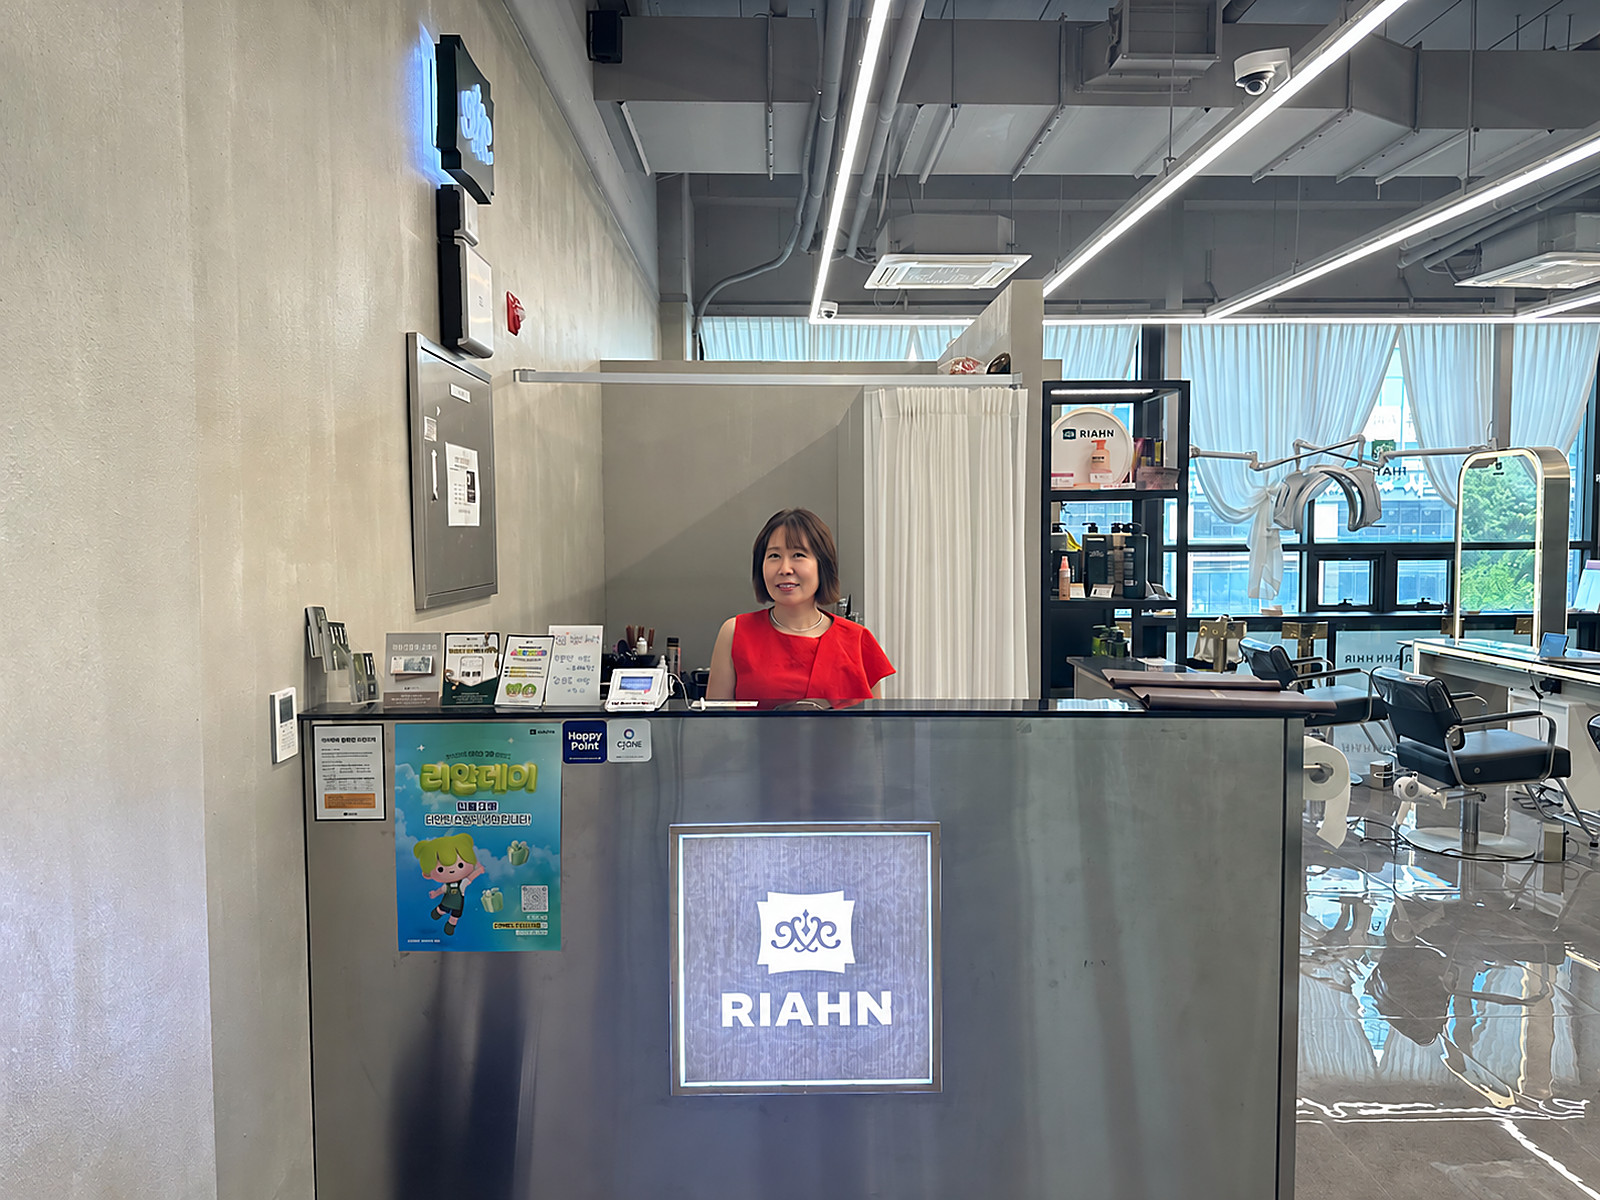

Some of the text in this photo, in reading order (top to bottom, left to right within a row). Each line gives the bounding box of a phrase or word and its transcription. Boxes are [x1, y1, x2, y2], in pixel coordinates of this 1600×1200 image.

[1080, 429, 1115, 438] RIAHN
[571, 741, 599, 751] Point
[420, 762, 538, 796] 리안데이
[721, 990, 893, 1028] RIAHN
